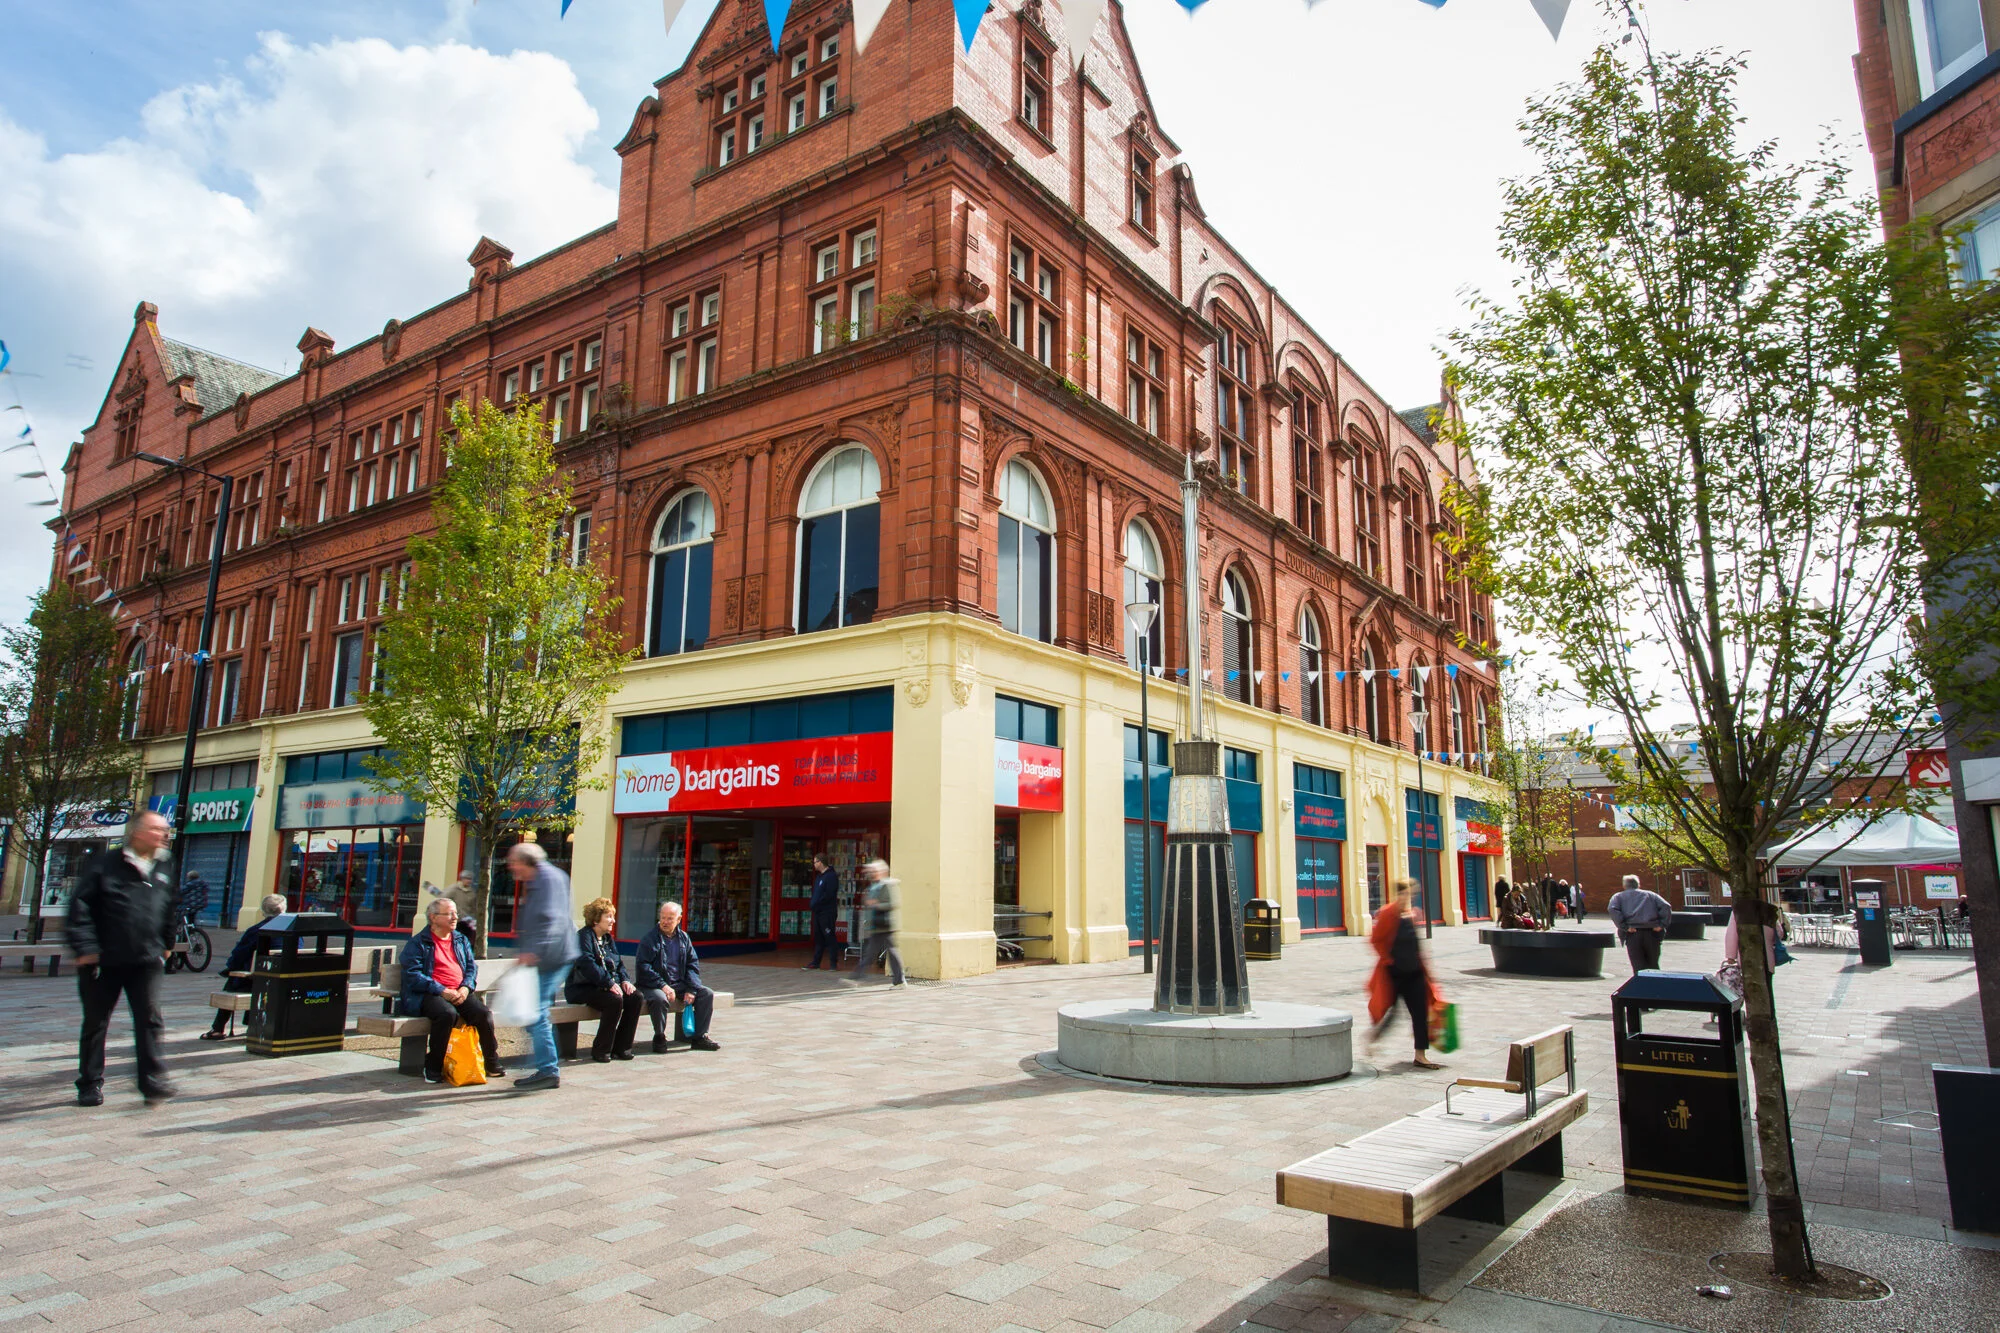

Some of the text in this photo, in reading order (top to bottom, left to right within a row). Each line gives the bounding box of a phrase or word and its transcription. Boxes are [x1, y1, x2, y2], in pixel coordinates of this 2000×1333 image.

[794, 753, 858, 769] TOP BRANDS
[997, 757, 1062, 779] home bargains
[625, 759, 780, 796] home bargains
[793, 769, 877, 787] BOTTOM PRICES
[191, 799, 240, 822] SPORTS
[1304, 804, 1314, 814] TOP
[96, 811, 128, 823] JJB
[1300, 815, 1339, 829] BOTTOM PRICES
[304, 996, 330, 1005] Council
[306, 990, 329, 999] Wigan
[1651, 1050, 1695, 1063] LITTER
